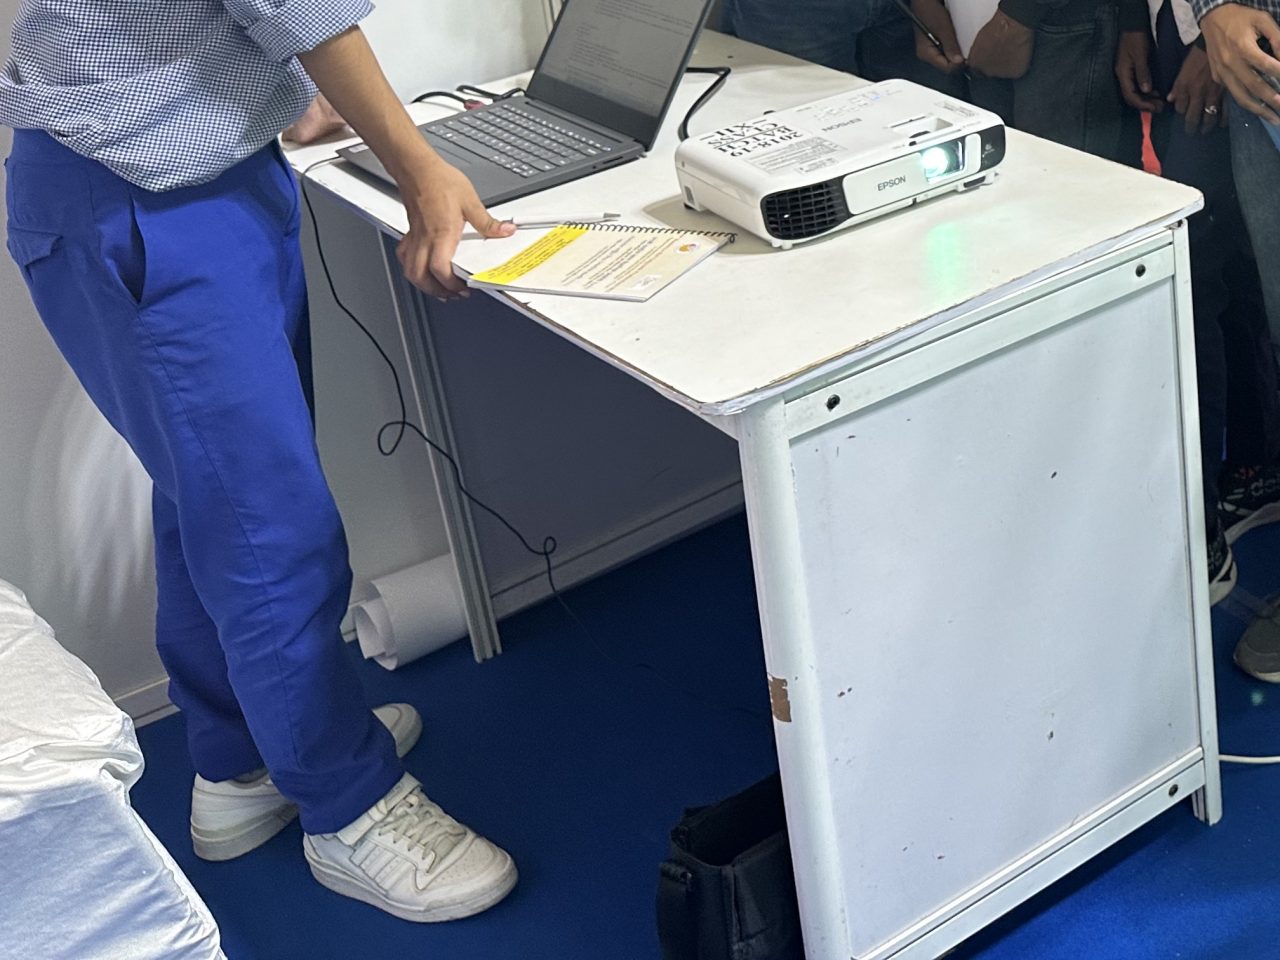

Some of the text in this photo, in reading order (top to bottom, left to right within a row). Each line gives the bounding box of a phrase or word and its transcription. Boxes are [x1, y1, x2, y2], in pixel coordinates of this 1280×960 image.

[708, 123, 778, 145] CLASS
[718, 126, 792, 153] BATCH
[731, 130, 802, 157] 2018-19
[877, 175, 907, 191] EPSON
